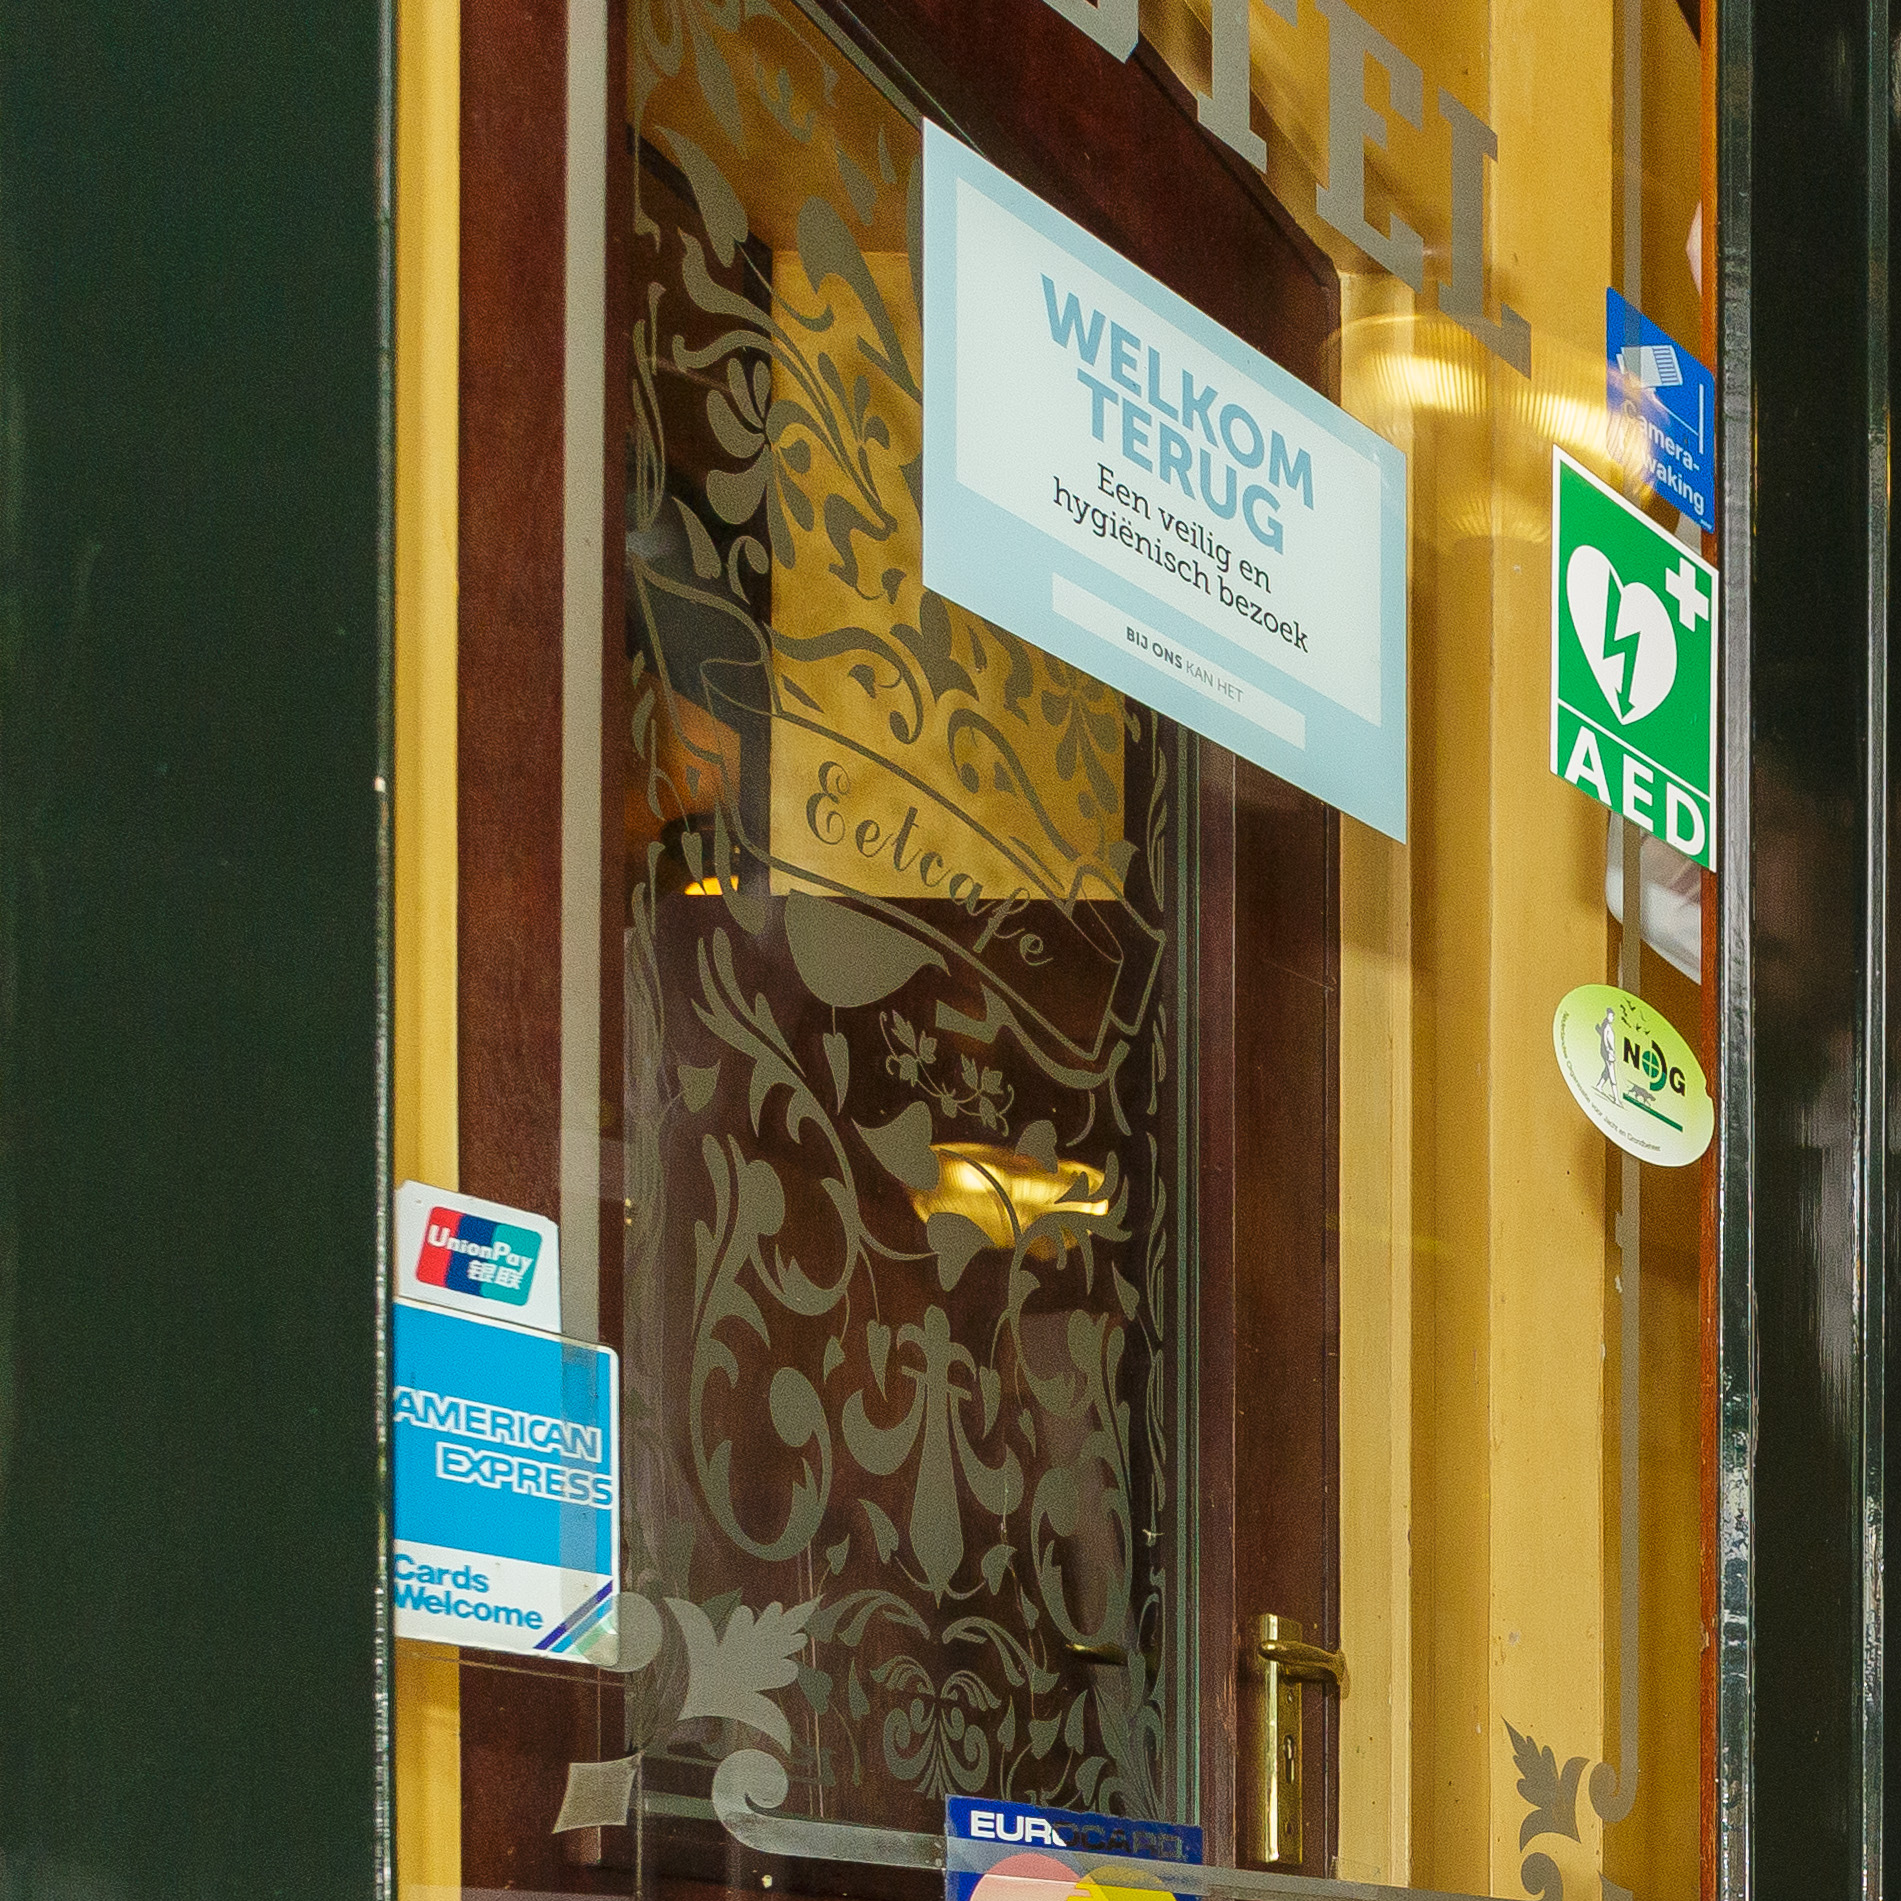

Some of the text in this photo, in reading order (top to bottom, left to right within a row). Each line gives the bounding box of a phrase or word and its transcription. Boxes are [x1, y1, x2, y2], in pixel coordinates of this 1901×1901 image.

[1042, 0, 1531, 380] TEL
[1040, 272, 1314, 511] WELKOM
[1077, 367, 1283, 556] TERUG
[1641, 453, 1705, 516] waking
[1053, 475, 1309, 654] hygiënisch bezoek
[1097, 462, 1272, 594] Een veilig en
[1126, 626, 1244, 703] BIJ ONS KAN HET
[1564, 725, 1706, 857] AED
[805, 760, 1054, 967] Eetcafe
[427, 1223, 534, 1276] UnionPay
[467, 1259, 524, 1291] 银联
[394, 1387, 602, 1463] AMERICAN
[436, 1440, 613, 1510] EXPRESS
[394, 1553, 491, 1594] Cards
[394, 1583, 544, 1631] Welcome
